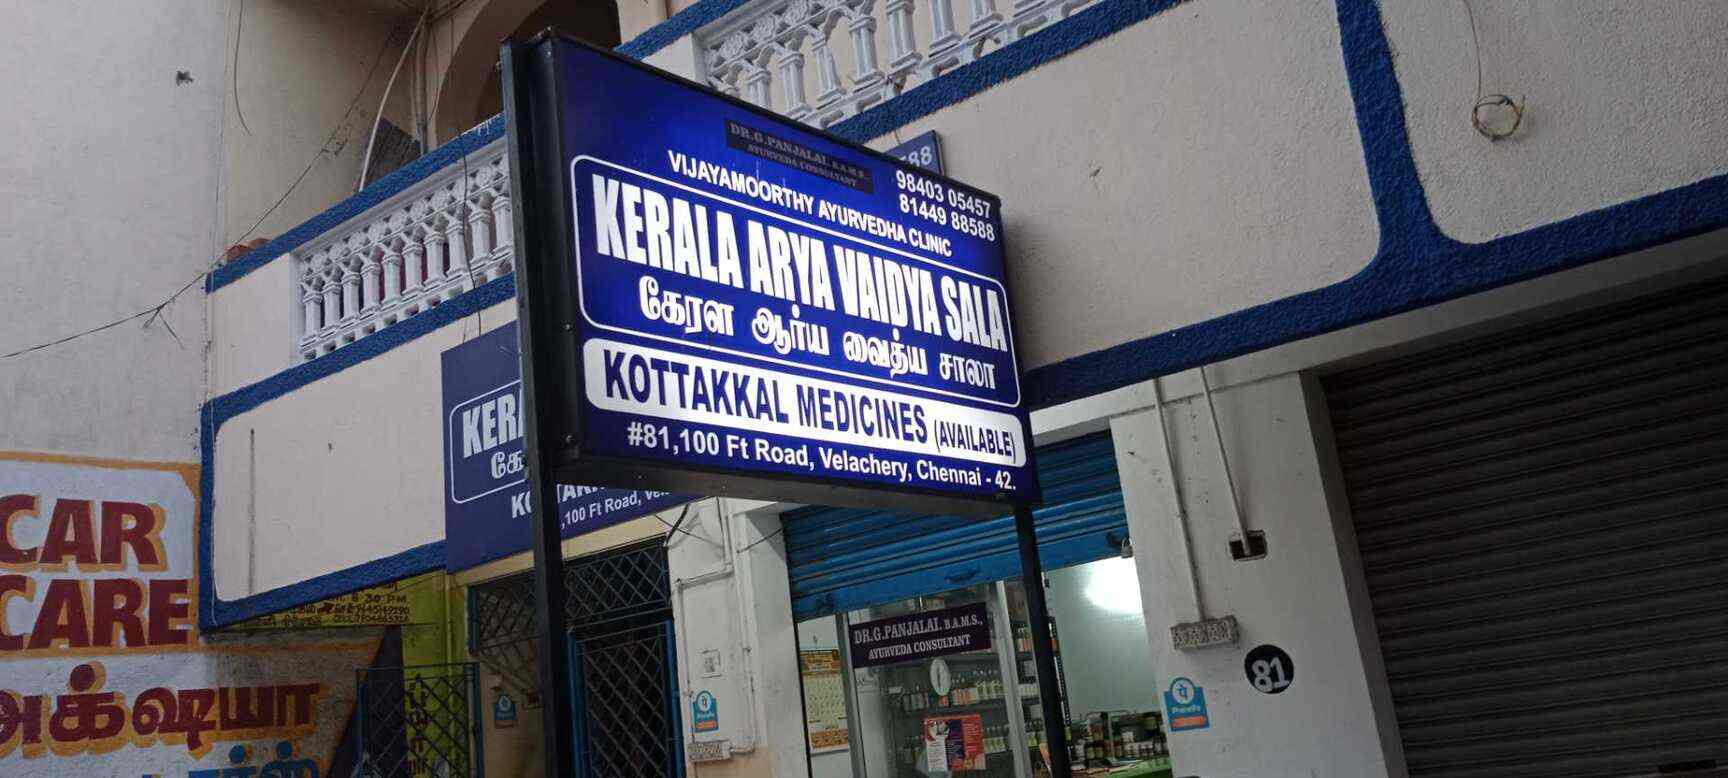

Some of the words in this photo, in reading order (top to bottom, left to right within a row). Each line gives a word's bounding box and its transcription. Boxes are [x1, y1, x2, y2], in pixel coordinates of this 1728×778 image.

[668, 150, 813, 215] VIJAYAMOORTHY
[818, 199, 906, 244] AYURVEDHA
[908, 223, 953, 257] CLINIC
[800, 162, 857, 187] CONSULTANT
[895, 169, 944, 202] 98403
[948, 188, 991, 219] 05457
[899, 193, 947, 225] 81449
[951, 209, 996, 242] 88588
[592, 173, 744, 289] KERALA
[747, 219, 836, 312] ARYA
[833, 244, 943, 336] VAIDYA
[940, 275, 1008, 352] SALA
[638, 275, 735, 337] கேரள
[751, 304, 830, 356] ஆர்ய
[843, 327, 929, 378] வைத்ய
[939, 352, 996, 390] சாலா
[462, 392, 524, 459] KER
[603, 349, 790, 425] KOTTAKKAL
[796, 383, 928, 444] MEDICINES
[933, 419, 1016, 465] (AVAILABLE)
[627, 421, 720, 456] #81,100
[726, 434, 750, 460] Ft
[754, 438, 815, 472] Road,
[819, 446, 914, 484] Velachery,
[916, 459, 982, 487] Chennai
[994, 470, 1017, 491] 42.
[0, 494, 163, 569] CAR
[589, 502, 602, 521] Ft
[604, 490, 642, 515] Road,
[0, 574, 192, 652] CARE
[868, 644, 913, 660] AYURVEDA
[913, 634, 971, 653] CONSULTANT
[1251, 656, 1289, 693] 81
